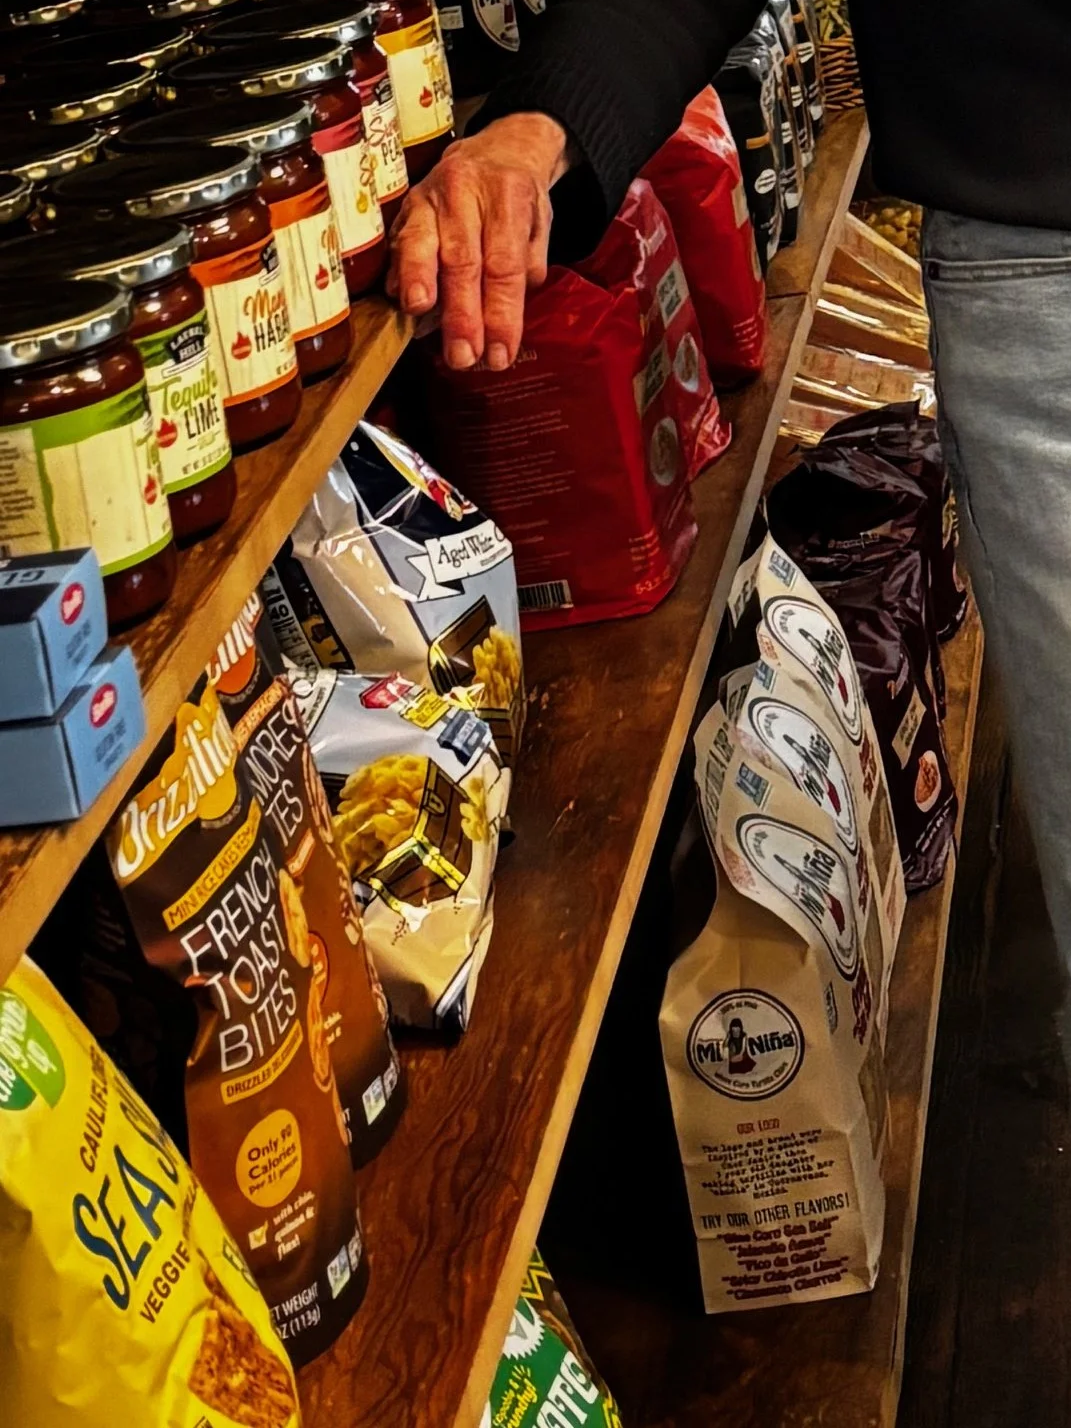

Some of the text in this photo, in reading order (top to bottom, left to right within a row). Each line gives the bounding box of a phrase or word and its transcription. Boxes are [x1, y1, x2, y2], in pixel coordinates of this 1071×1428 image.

[184, 393, 221, 440] LIME
[180, 837, 280, 977] FRENCH
[205, 904, 288, 1020] TOAST
[218, 968, 298, 1073] BITES
[696, 1031, 795, 1064] Mi Niña
[248, 1135, 279, 1162] Only
[248, 1142, 298, 1181] Calories
[72, 1143, 178, 1311] SEA
[700, 1192, 850, 1230] TRY OUR OTHER FLAVORS!
[281, 1280, 319, 1317] WEIGHT
